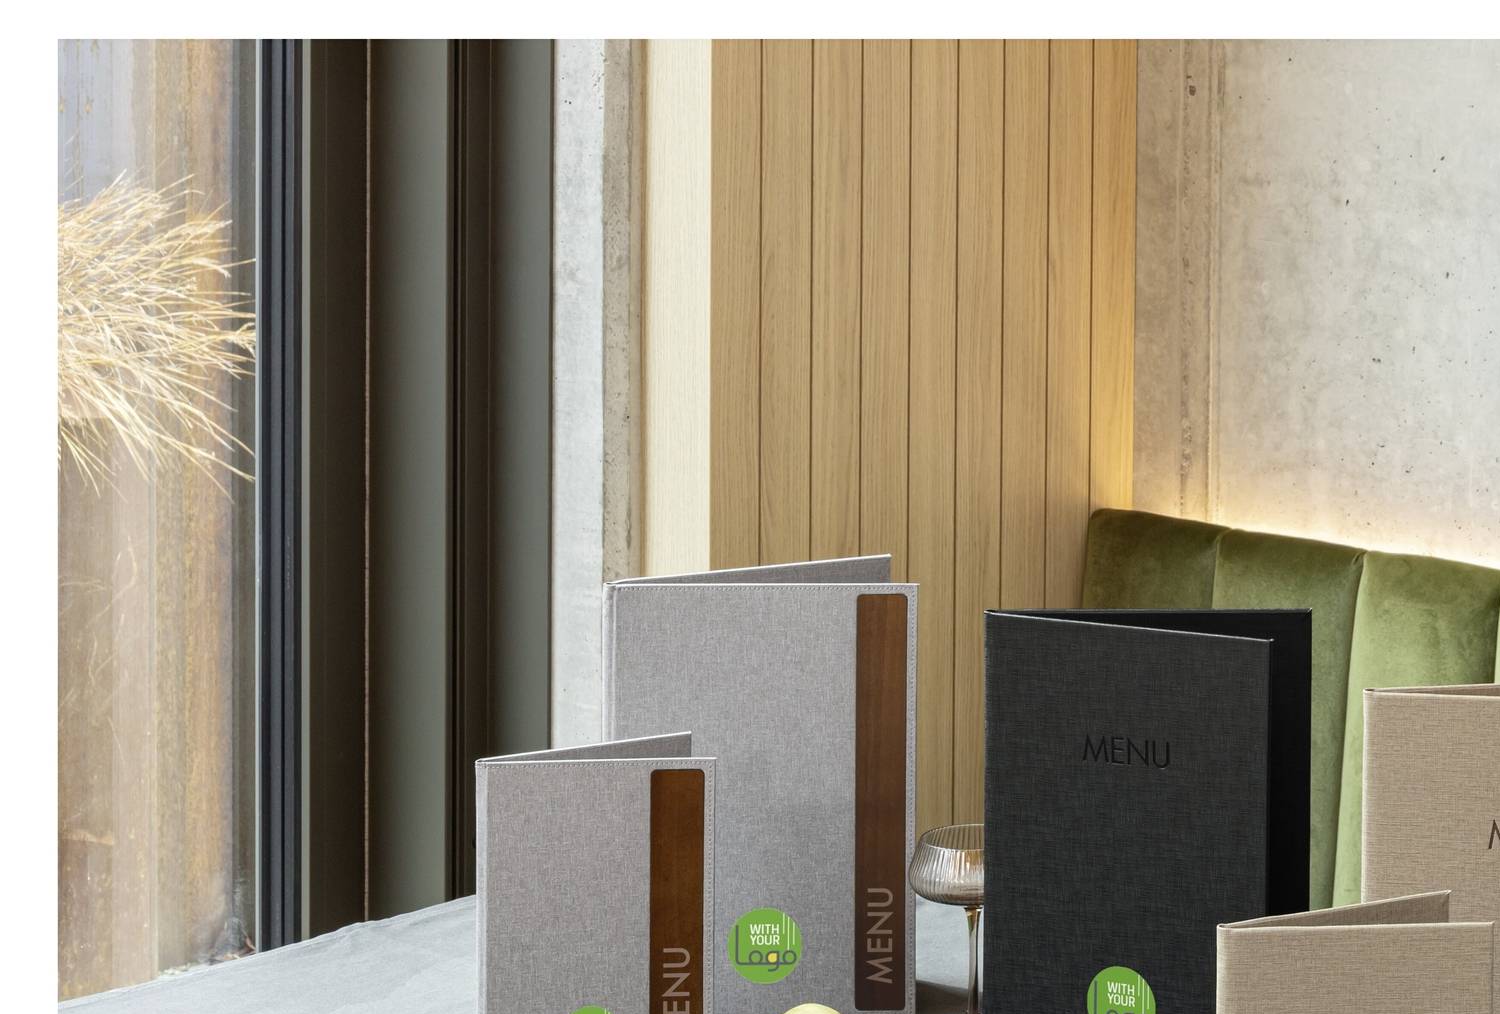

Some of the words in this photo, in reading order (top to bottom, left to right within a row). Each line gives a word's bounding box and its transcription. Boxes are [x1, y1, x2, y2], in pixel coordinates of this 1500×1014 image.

[1081, 734, 1171, 769] MENU
[749, 924, 780, 935] WITH
[867, 886, 894, 985] MENU
[749, 935, 780, 946] YOUR
[1106, 981, 1135, 996] WITH
[1106, 992, 1136, 1008] YOUR
